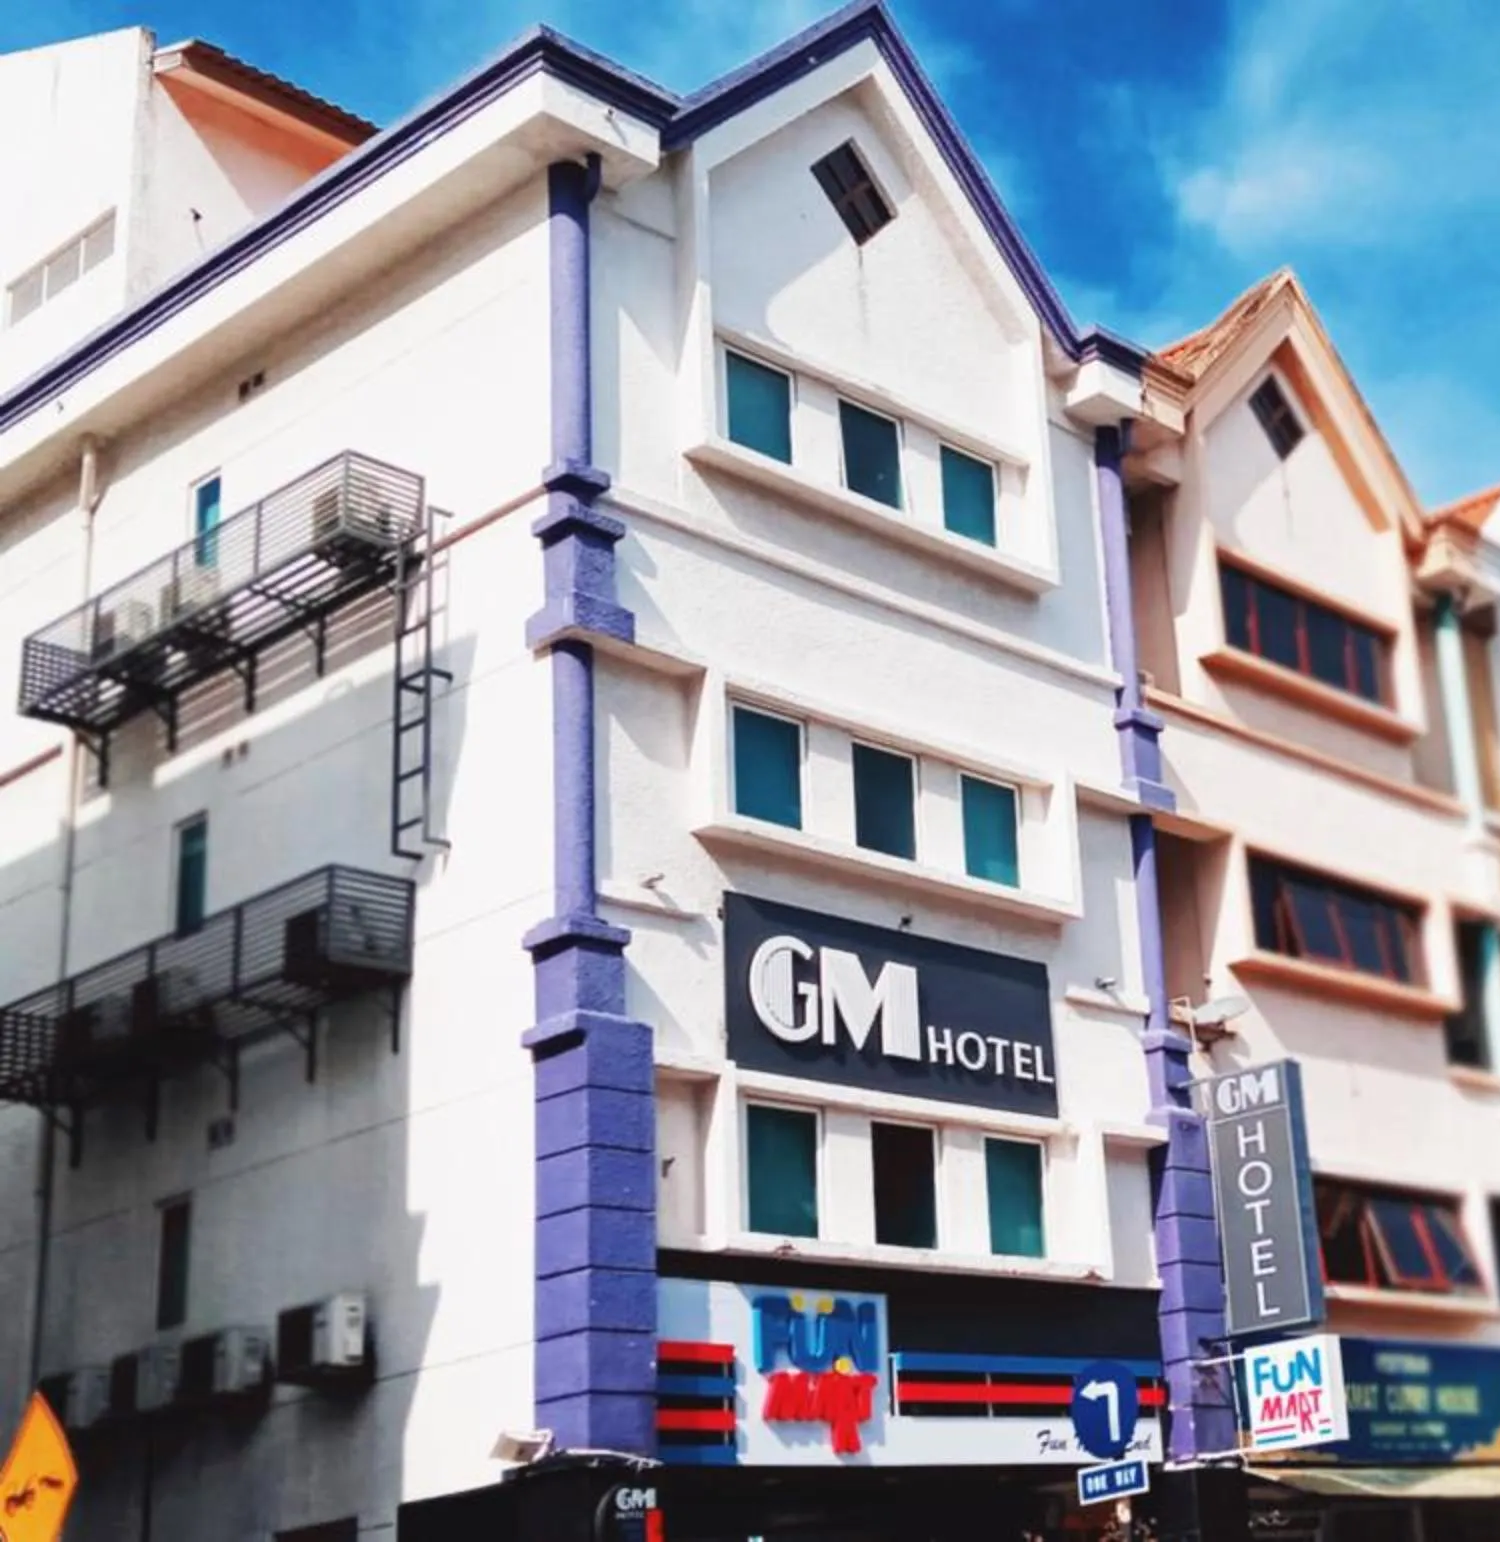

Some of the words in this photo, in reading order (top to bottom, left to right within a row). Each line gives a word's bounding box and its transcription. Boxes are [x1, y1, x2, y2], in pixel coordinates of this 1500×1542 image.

[749, 935, 922, 1061] GM
[927, 1025, 1055, 1083] HOTEL
[1216, 1067, 1280, 1115] GM
[1237, 1120, 1281, 1317] HOTEL
[752, 1293, 878, 1374] FUN
[1253, 1347, 1322, 1396] FUN
[1260, 1388, 1323, 1434] MART
[615, 1487, 658, 1510] GM
[1085, 1473, 1107, 1494] ONE
[1114, 1466, 1138, 1487] WAY
